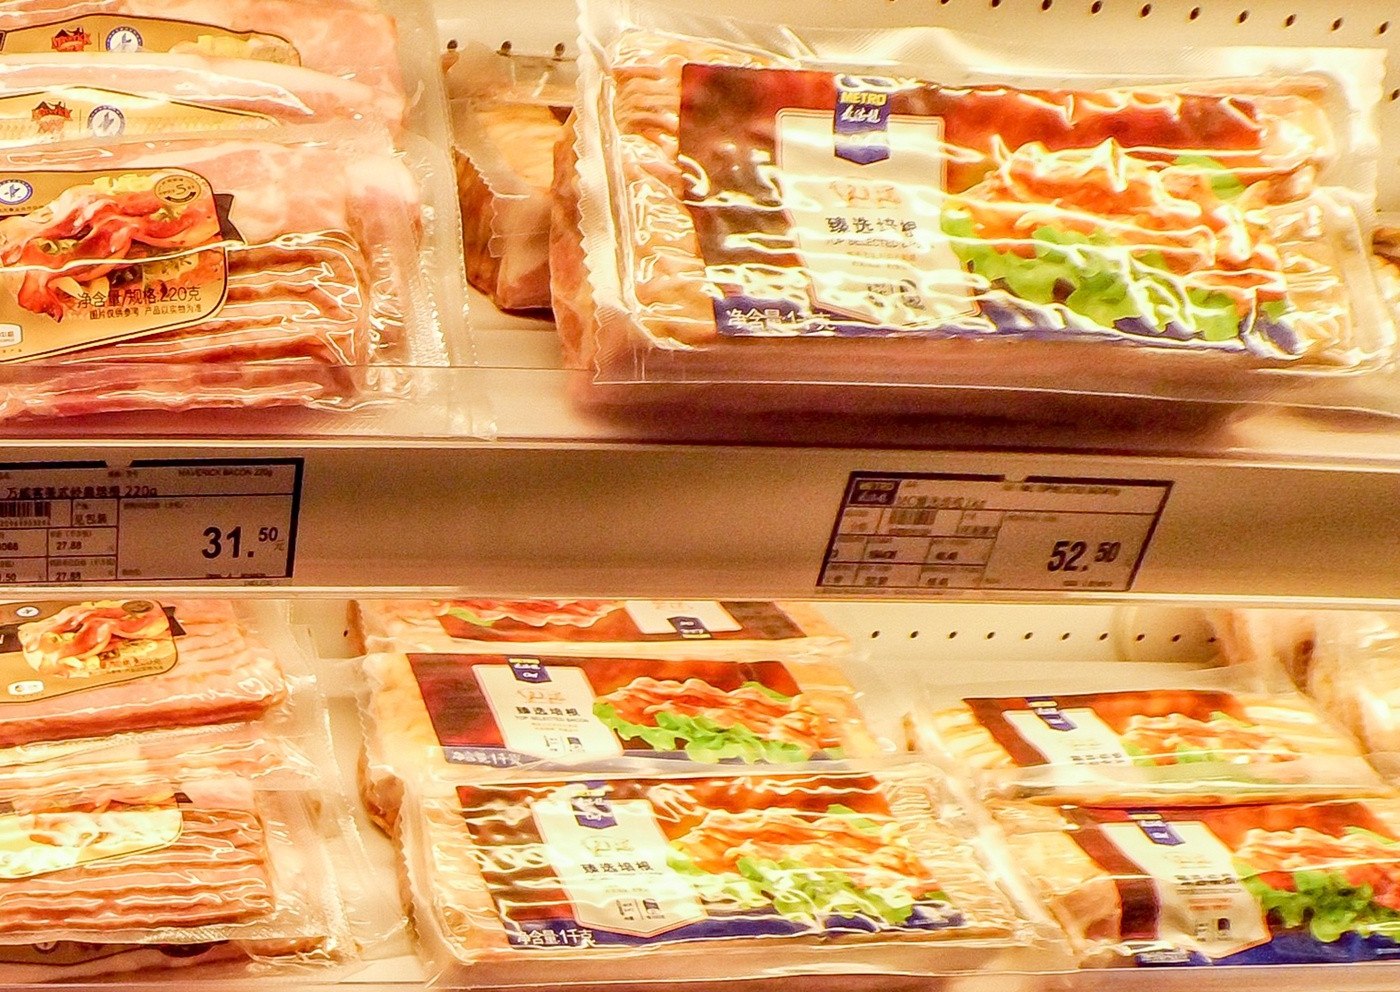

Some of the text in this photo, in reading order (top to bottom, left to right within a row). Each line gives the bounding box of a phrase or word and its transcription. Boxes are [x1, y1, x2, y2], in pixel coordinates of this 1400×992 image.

[840, 91, 887, 107] METRO
[201, 526, 279, 559] 31.50
[1047, 540, 1122, 572] 52.50
